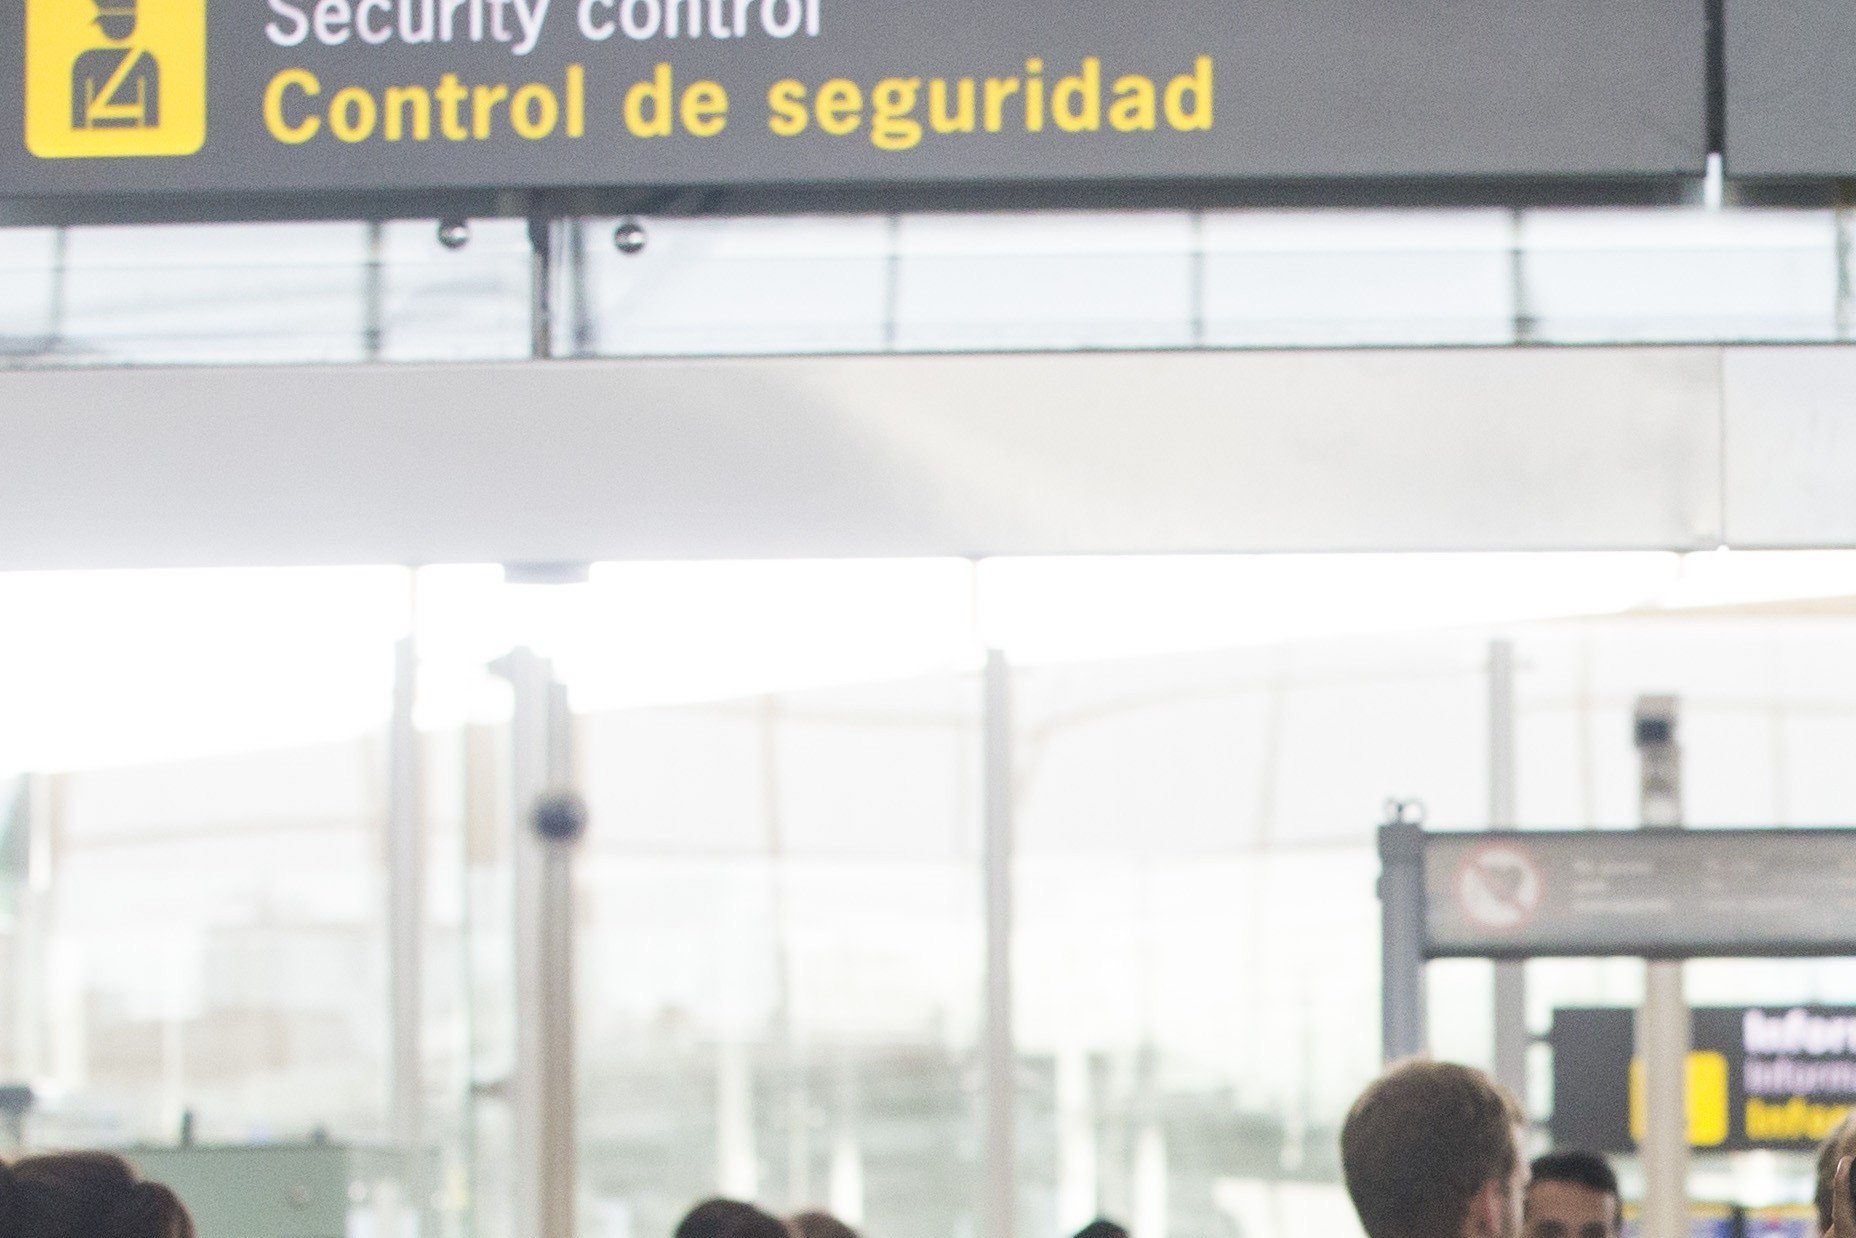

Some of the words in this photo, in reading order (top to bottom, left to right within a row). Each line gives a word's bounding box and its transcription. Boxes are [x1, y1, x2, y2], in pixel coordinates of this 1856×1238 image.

[264, 0, 553, 56] Security
[577, 0, 822, 41] control
[262, 63, 586, 145] Control
[623, 62, 729, 138] de
[767, 55, 1214, 152] seguridad
